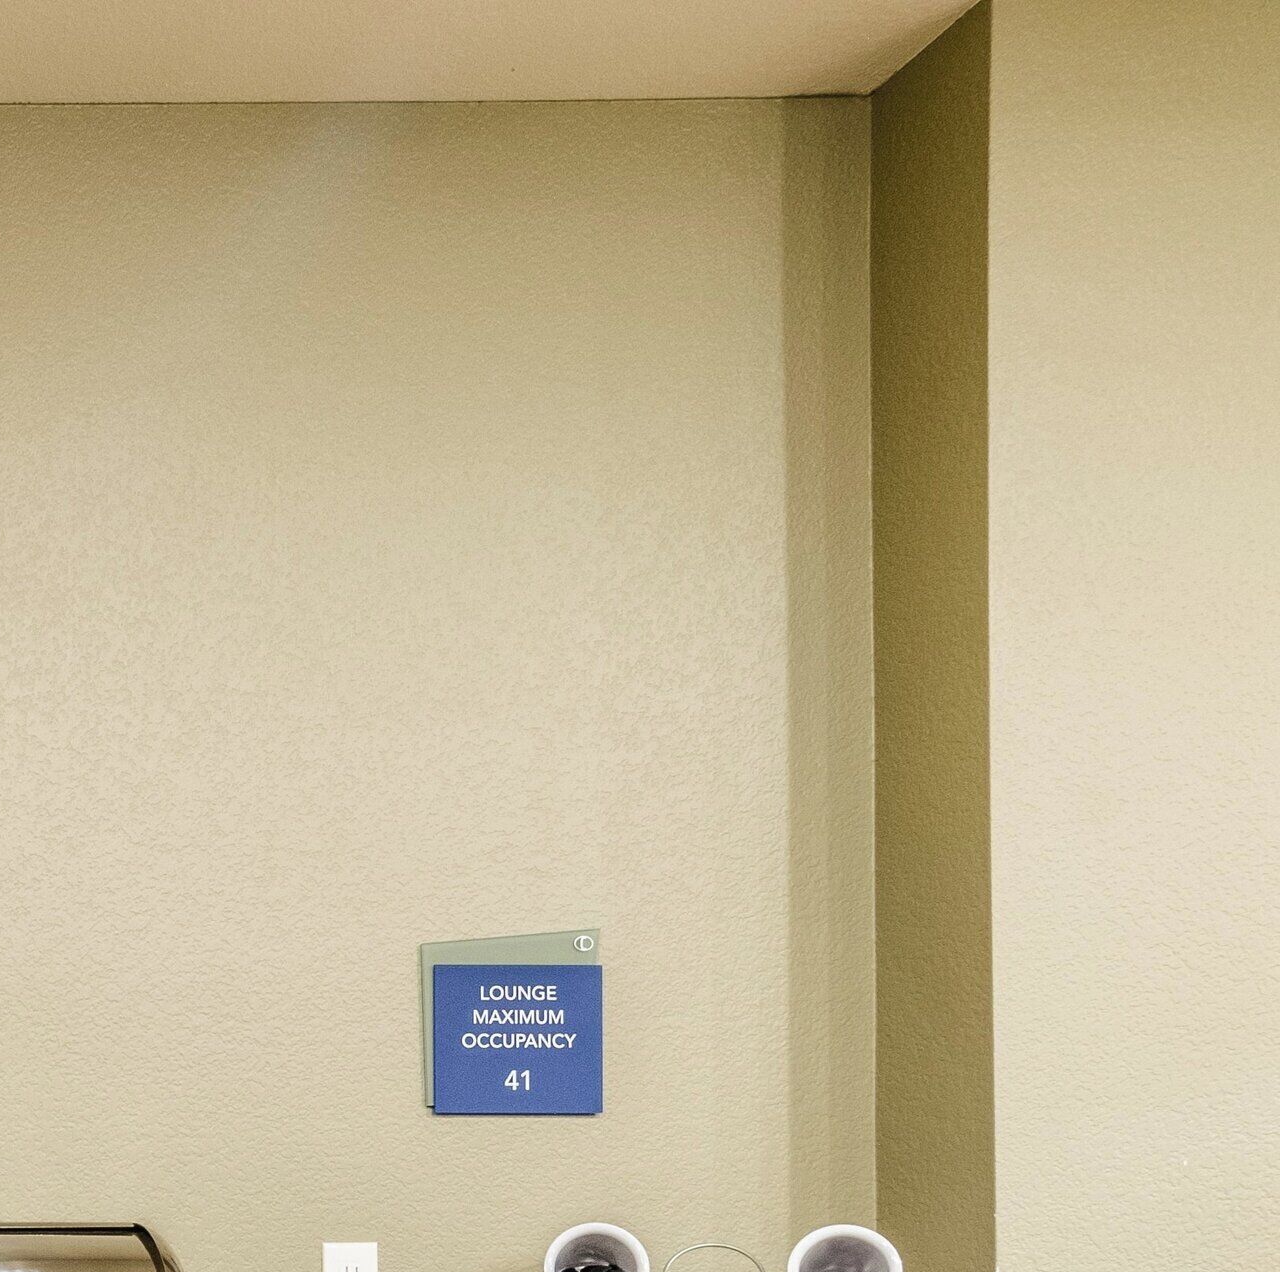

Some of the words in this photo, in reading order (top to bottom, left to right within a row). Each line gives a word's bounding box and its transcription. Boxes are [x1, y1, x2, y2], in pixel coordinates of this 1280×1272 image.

[479, 985, 557, 1001] LOUNGE
[472, 1009, 564, 1025] MAXIMUM
[461, 1033, 577, 1048] OCCUPANCY
[504, 1069, 531, 1091] 41
